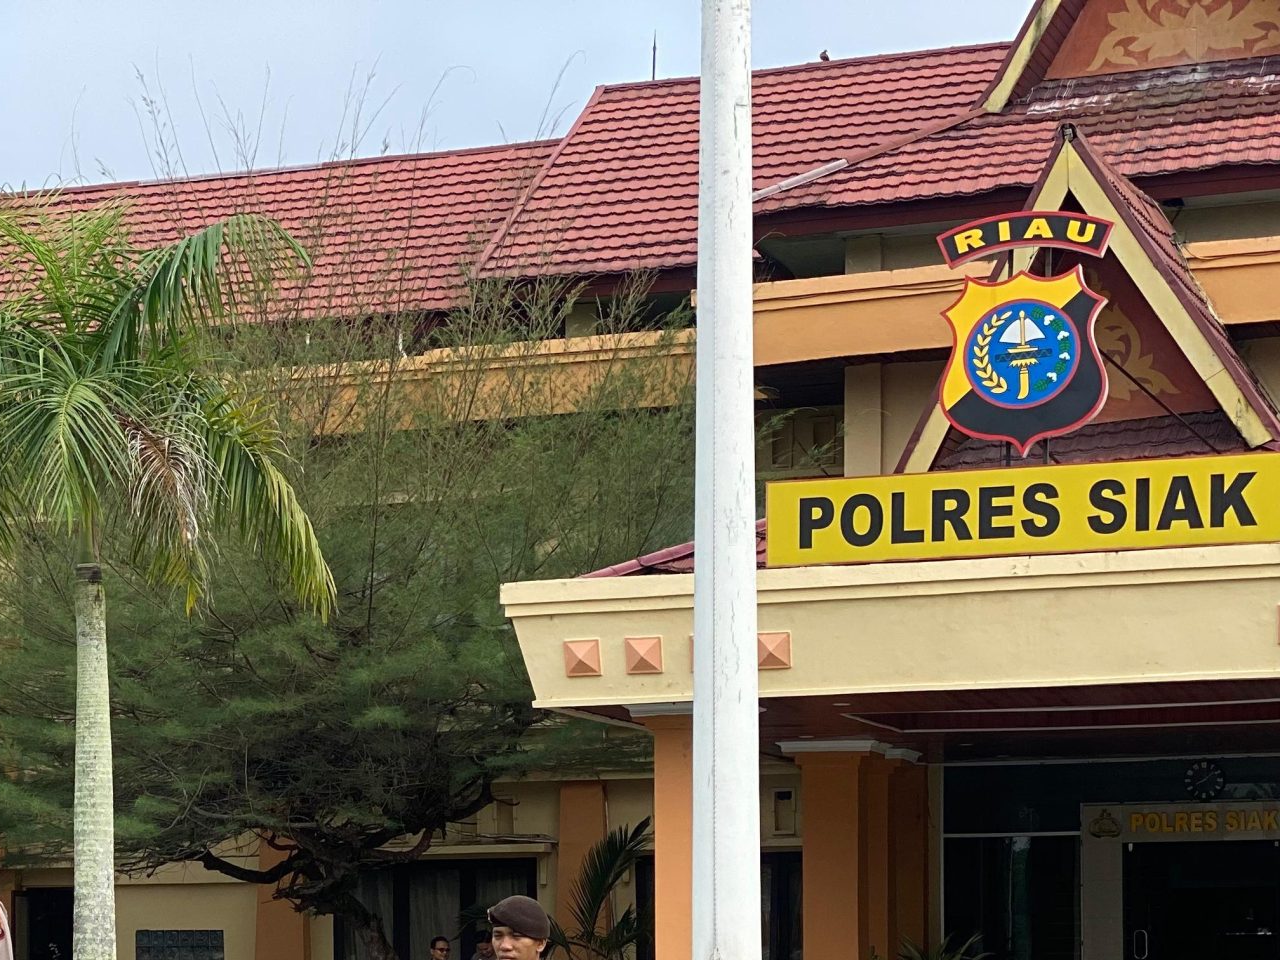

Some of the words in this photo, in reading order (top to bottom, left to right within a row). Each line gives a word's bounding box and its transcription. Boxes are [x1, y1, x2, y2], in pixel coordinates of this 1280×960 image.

[953, 217, 1096, 255] RIAU
[798, 482, 1061, 549] POLRES
[1086, 471, 1258, 534] SIAK
[1130, 811, 1218, 833] POLRES
[1225, 808, 1279, 832] SIAK
